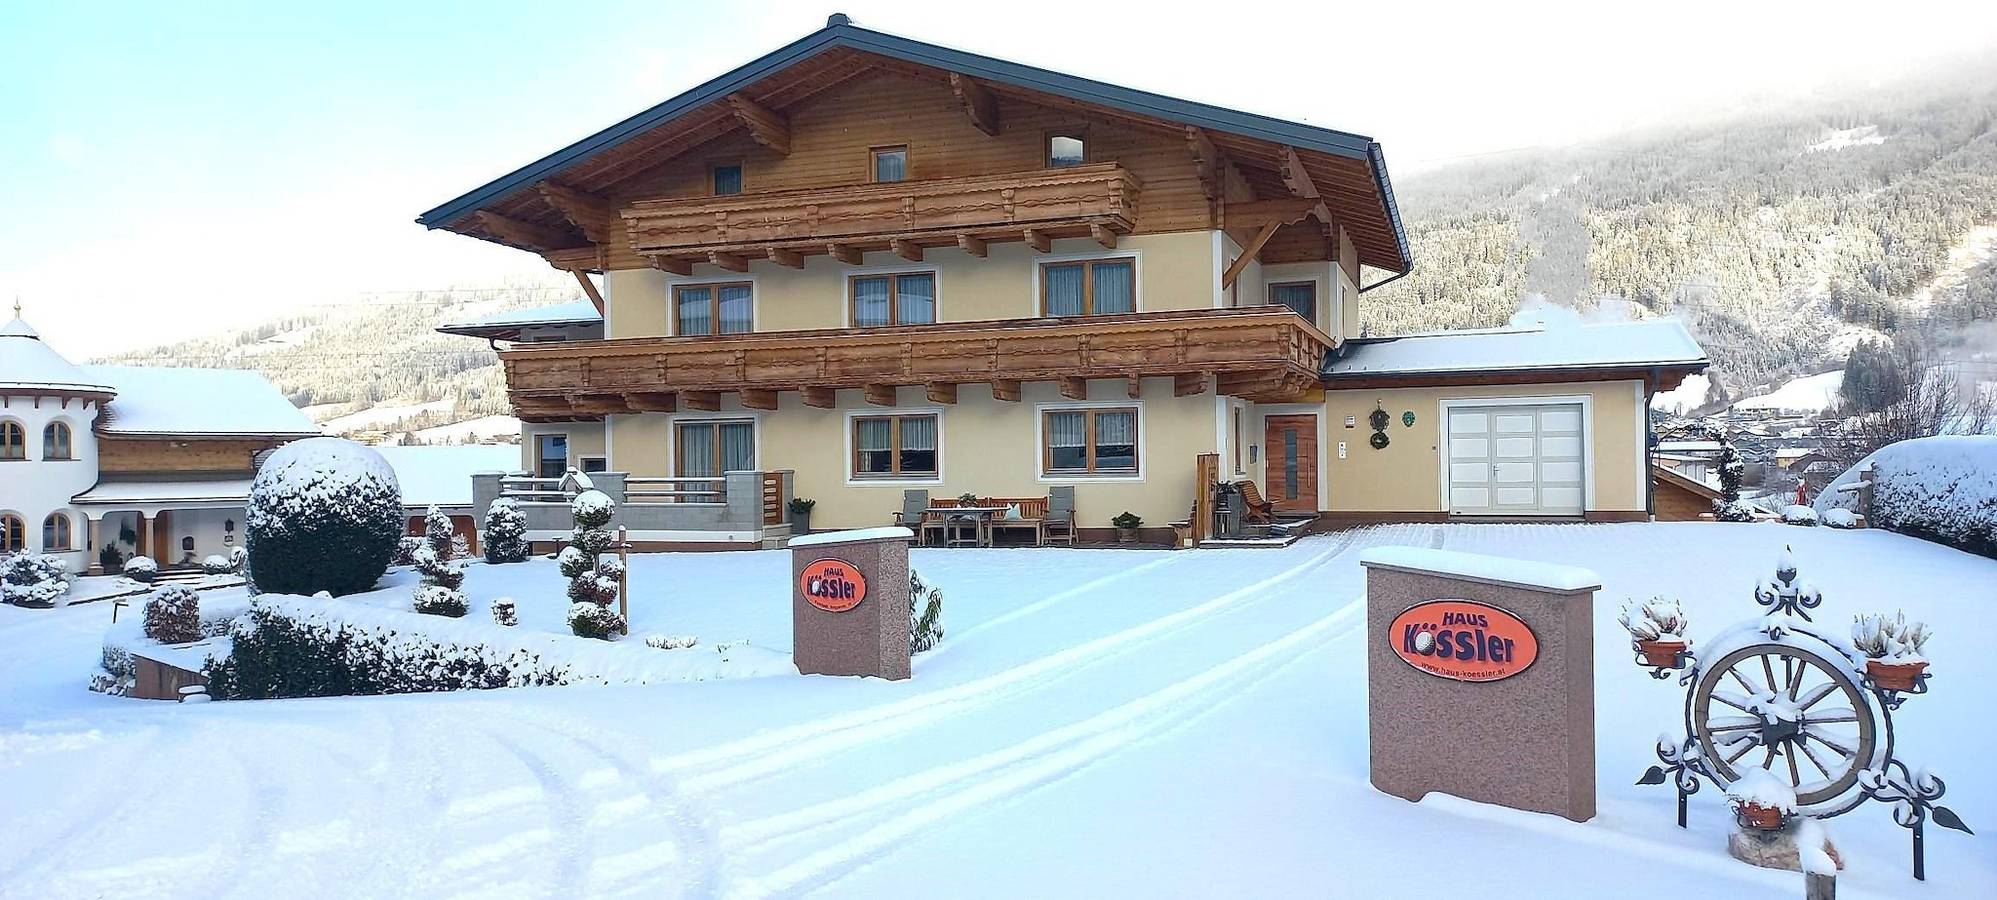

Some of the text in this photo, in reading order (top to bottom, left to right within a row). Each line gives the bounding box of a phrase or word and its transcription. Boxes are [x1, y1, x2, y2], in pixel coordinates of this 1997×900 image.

[824, 567, 844, 577] HAUS
[1442, 612, 1488, 627] HAUS
[1403, 623, 1514, 663] Kössler
[1421, 662, 1506, 678] www.haus-koessler.at
